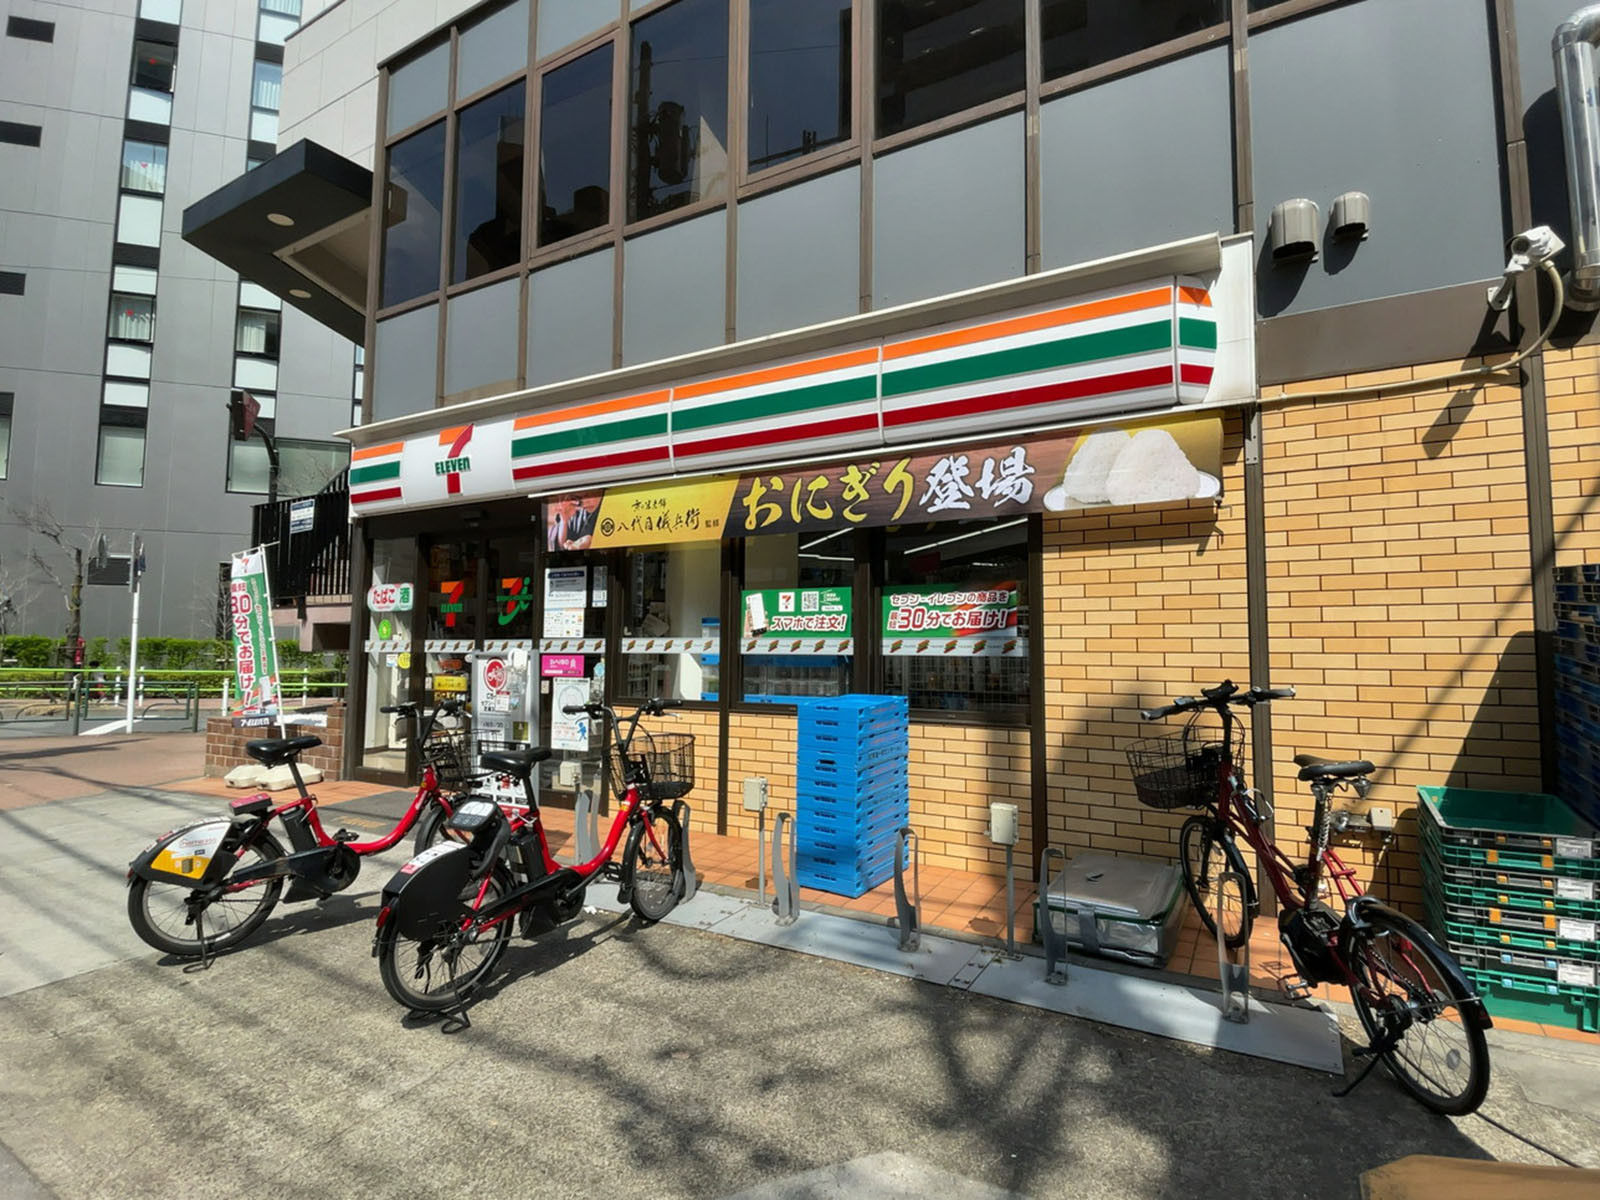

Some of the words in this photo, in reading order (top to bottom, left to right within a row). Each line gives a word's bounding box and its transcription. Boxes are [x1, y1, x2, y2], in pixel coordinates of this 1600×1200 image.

[439, 423, 474, 494] 7
[742, 446, 1035, 530] おにぎり登場
[373, 588, 395, 604] たばこ
[400, 587, 410, 603] 酒
[771, 615, 846, 631] スマホで注文!
